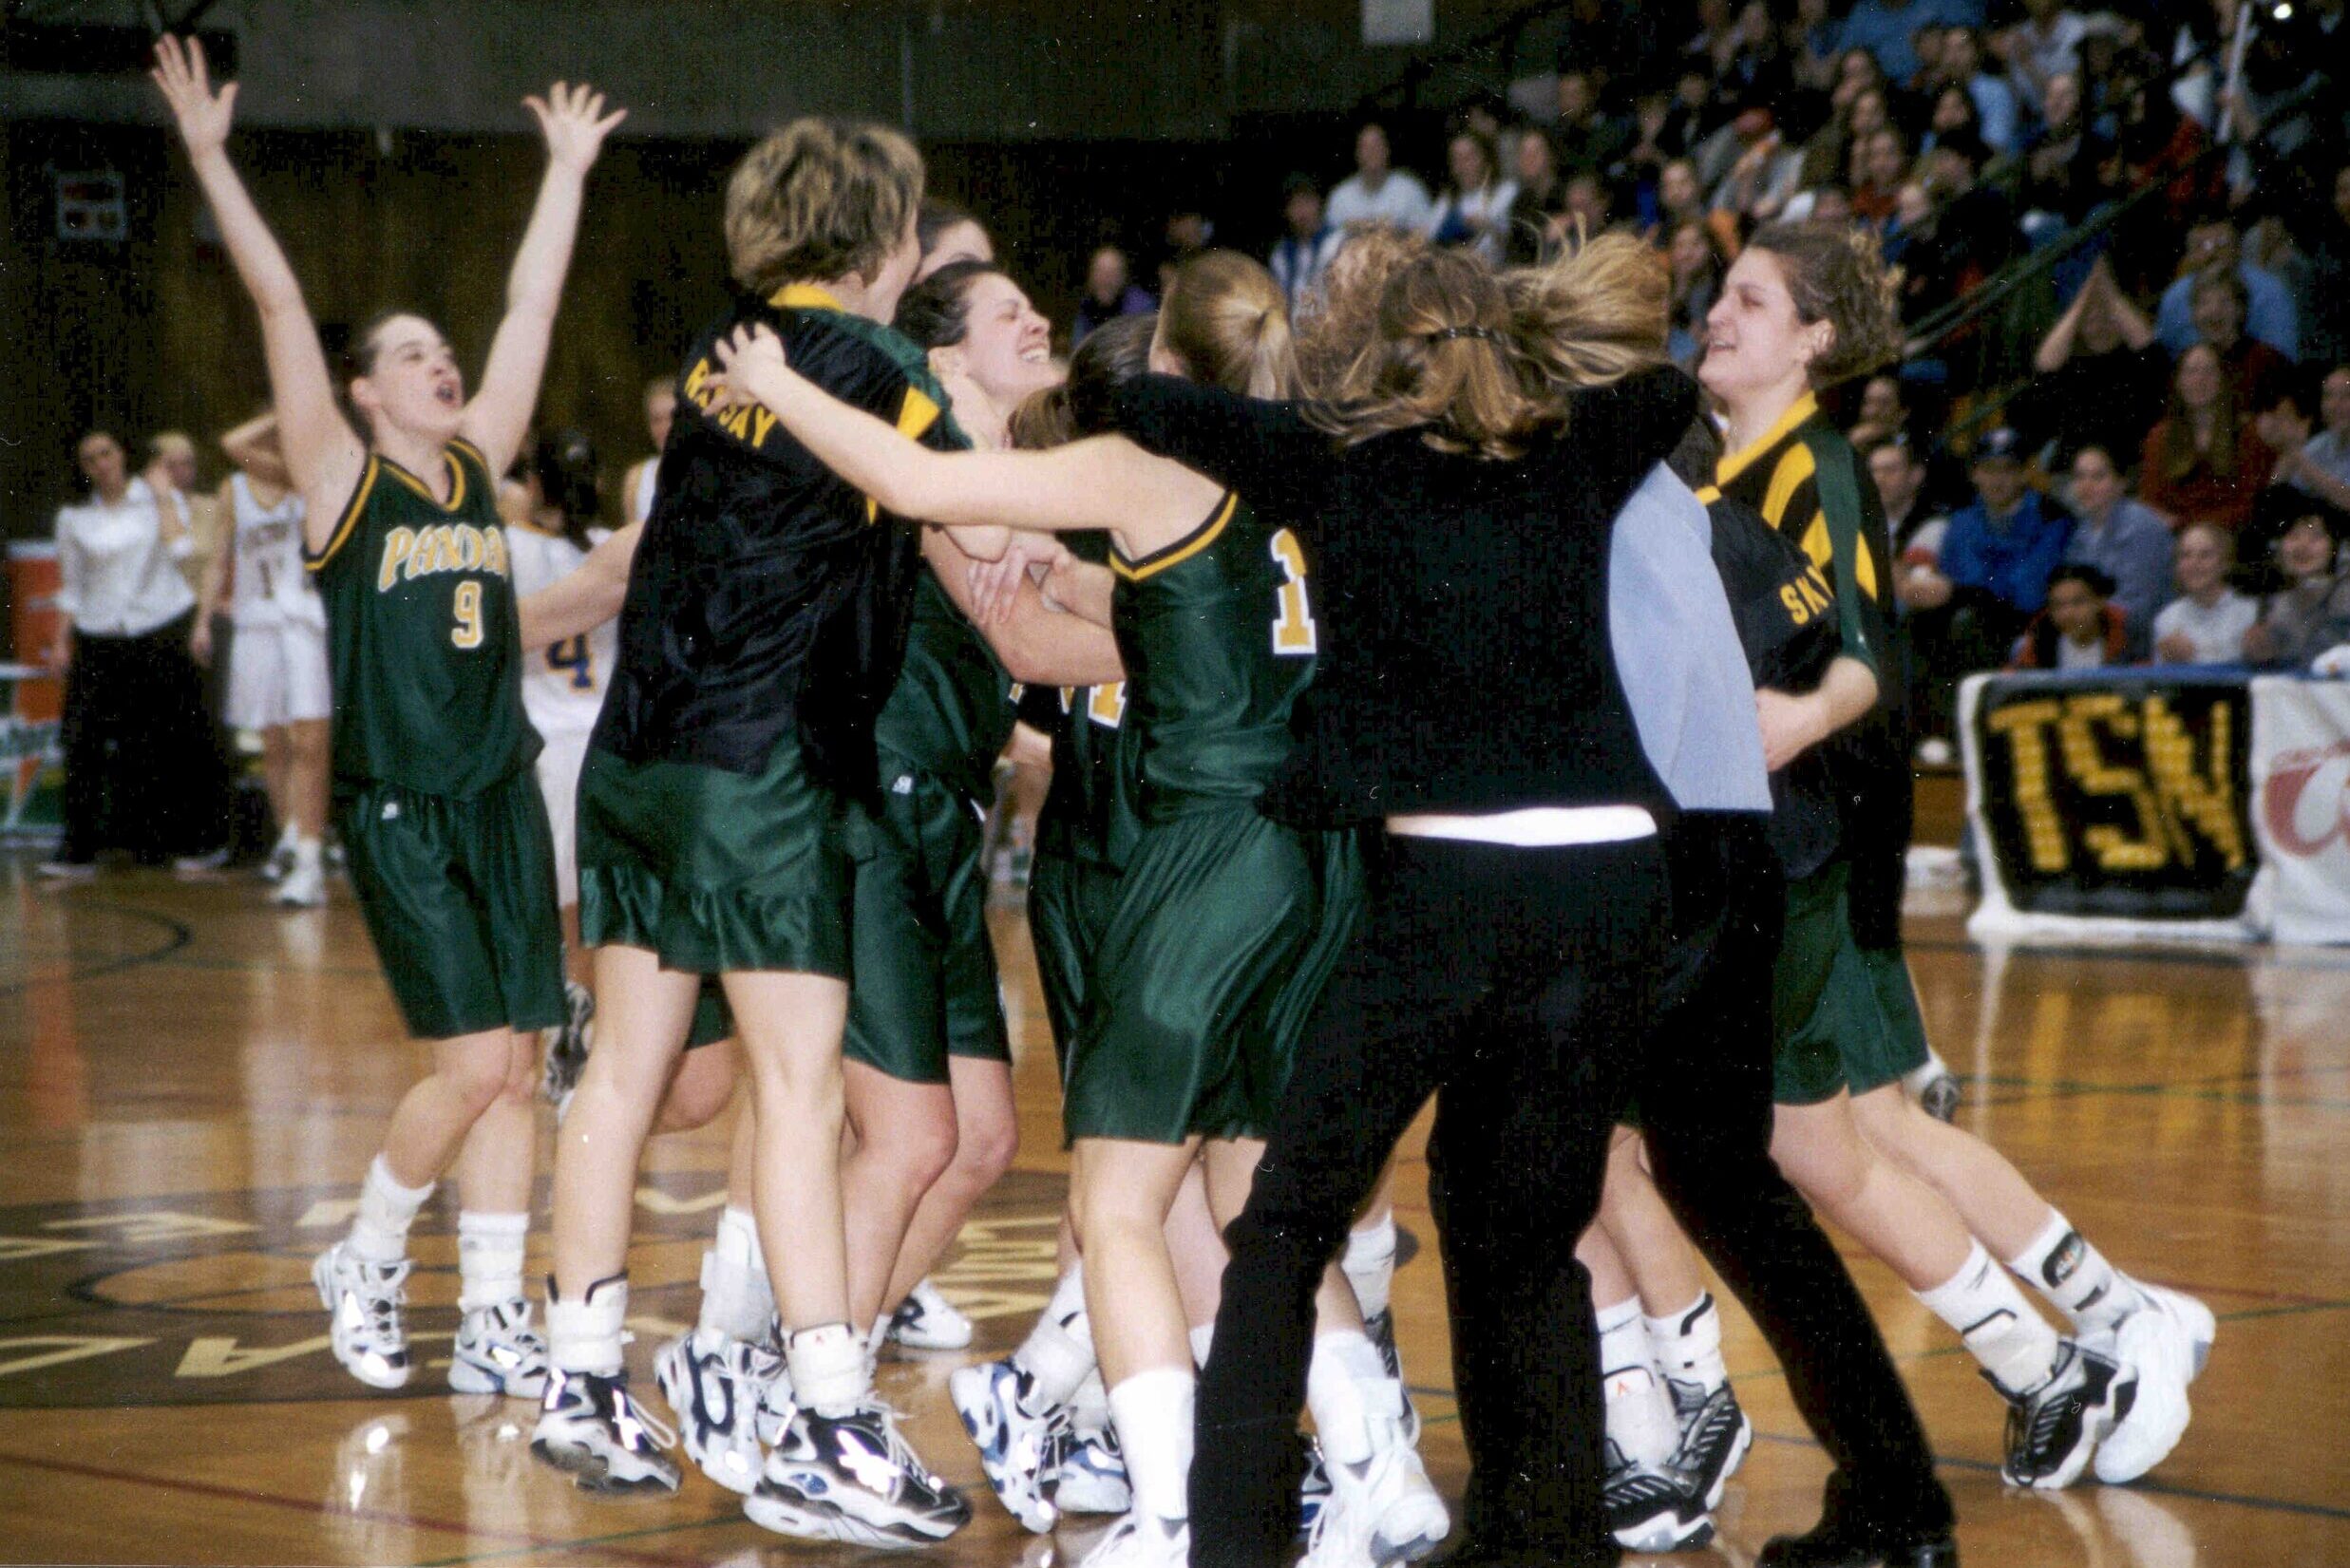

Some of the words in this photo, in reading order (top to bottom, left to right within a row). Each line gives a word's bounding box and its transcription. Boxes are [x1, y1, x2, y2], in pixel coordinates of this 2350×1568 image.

[451, 580, 483, 649] 9
[1270, 528, 1317, 655] 1
[544, 631, 597, 694] 4
[1989, 694, 2246, 873] TSN
